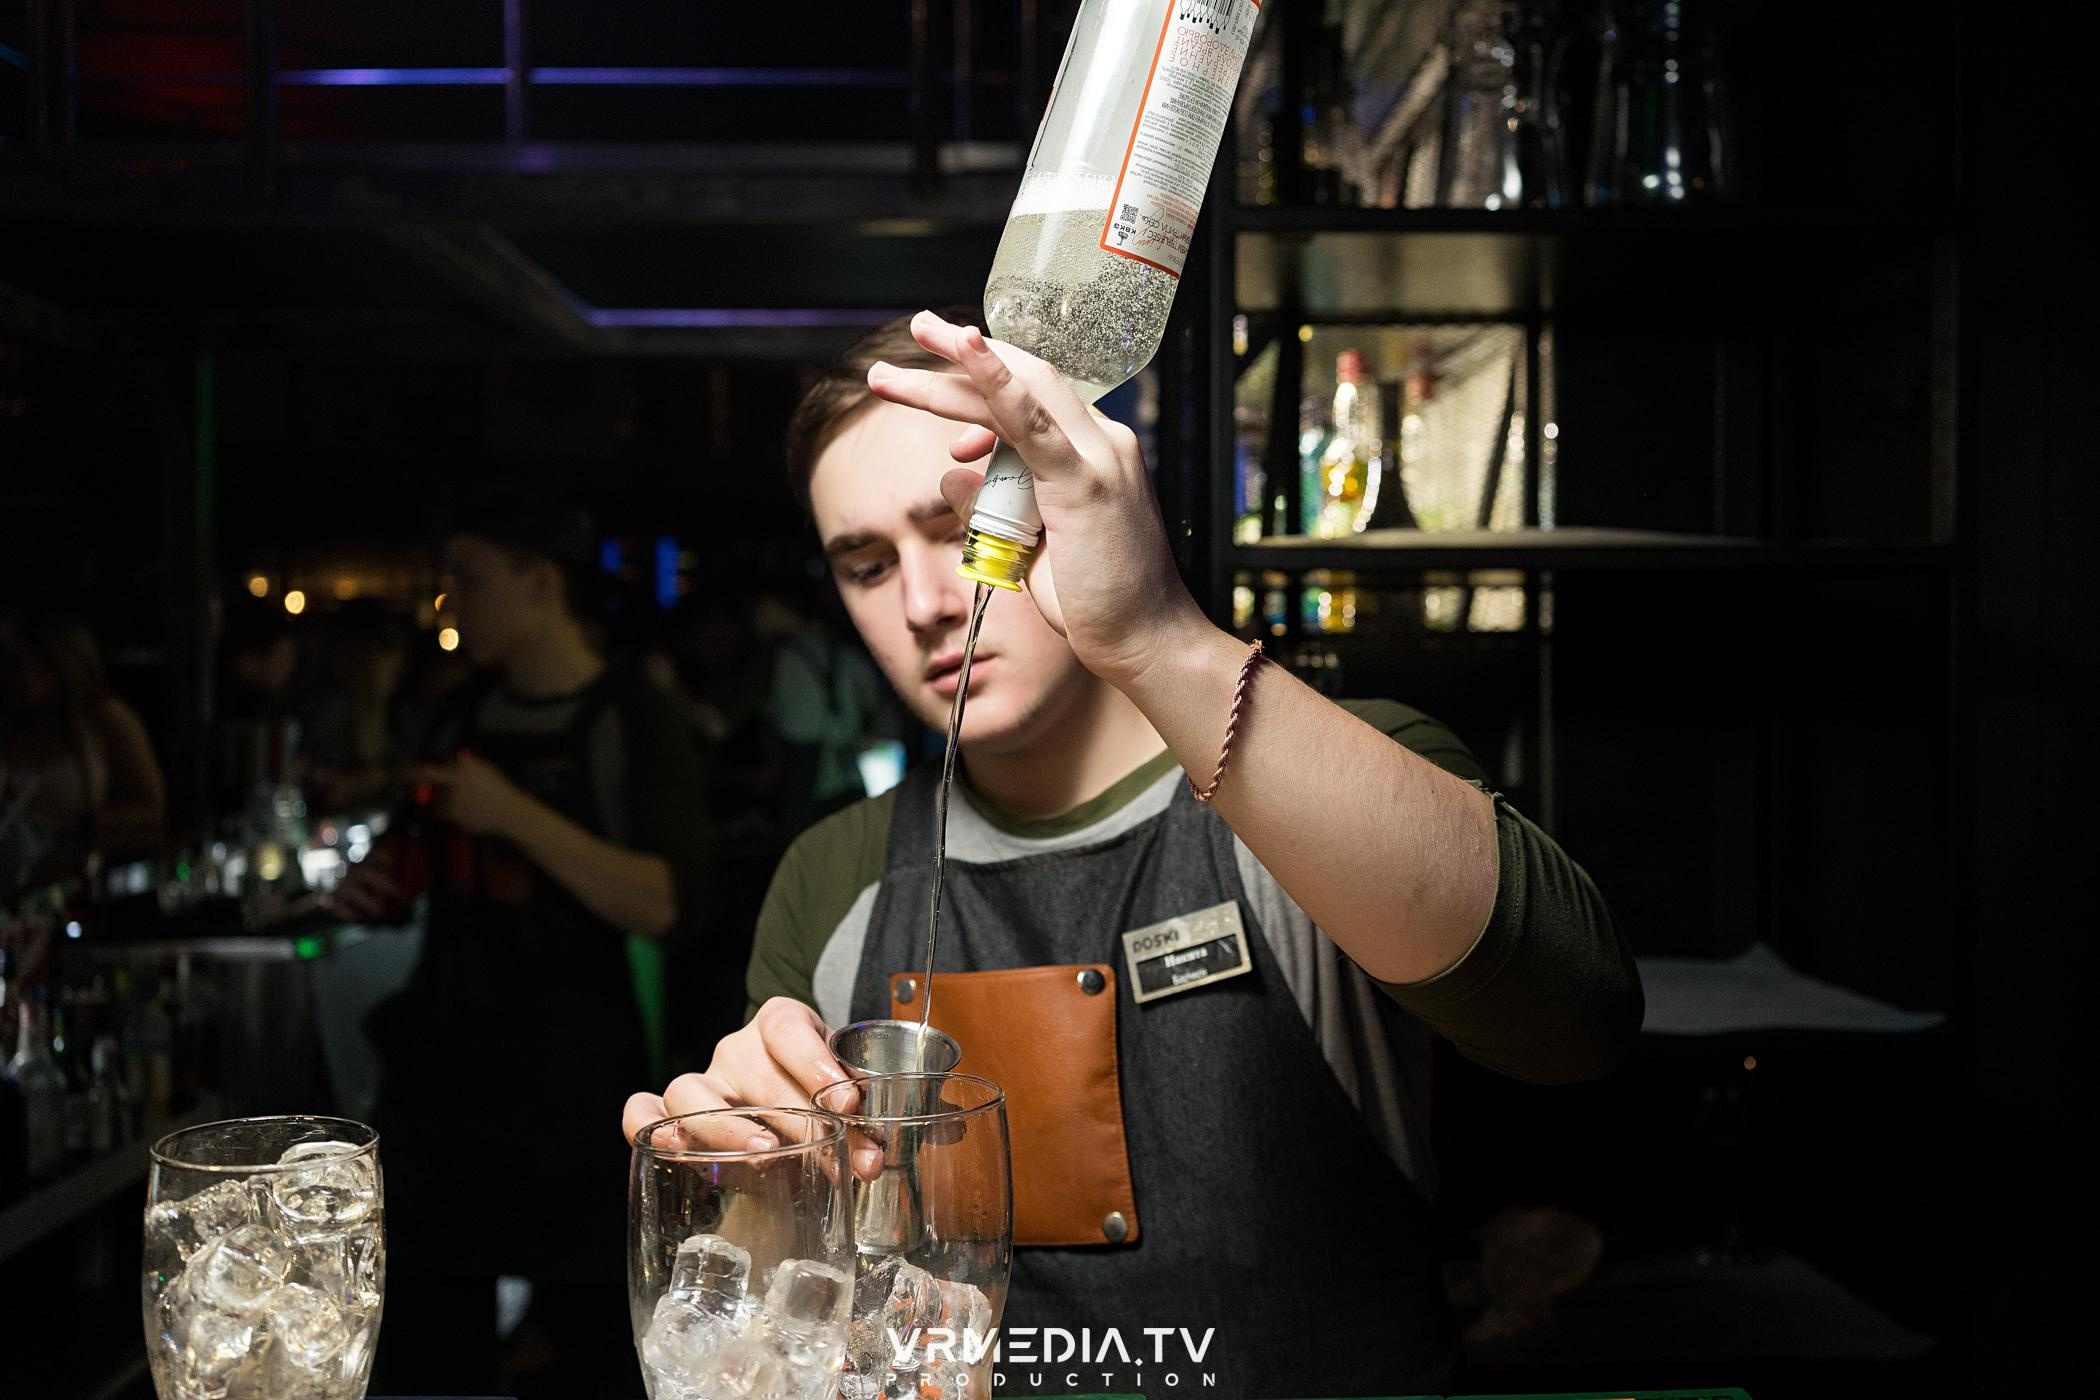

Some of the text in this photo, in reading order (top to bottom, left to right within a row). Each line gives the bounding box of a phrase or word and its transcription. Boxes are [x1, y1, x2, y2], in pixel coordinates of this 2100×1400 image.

[1173, 32, 1213, 58] ВРЕДИТ
[1176, 24, 1230, 54] ЗДОРОВЬЮ
[1132, 928, 1180, 954] DOSKI
